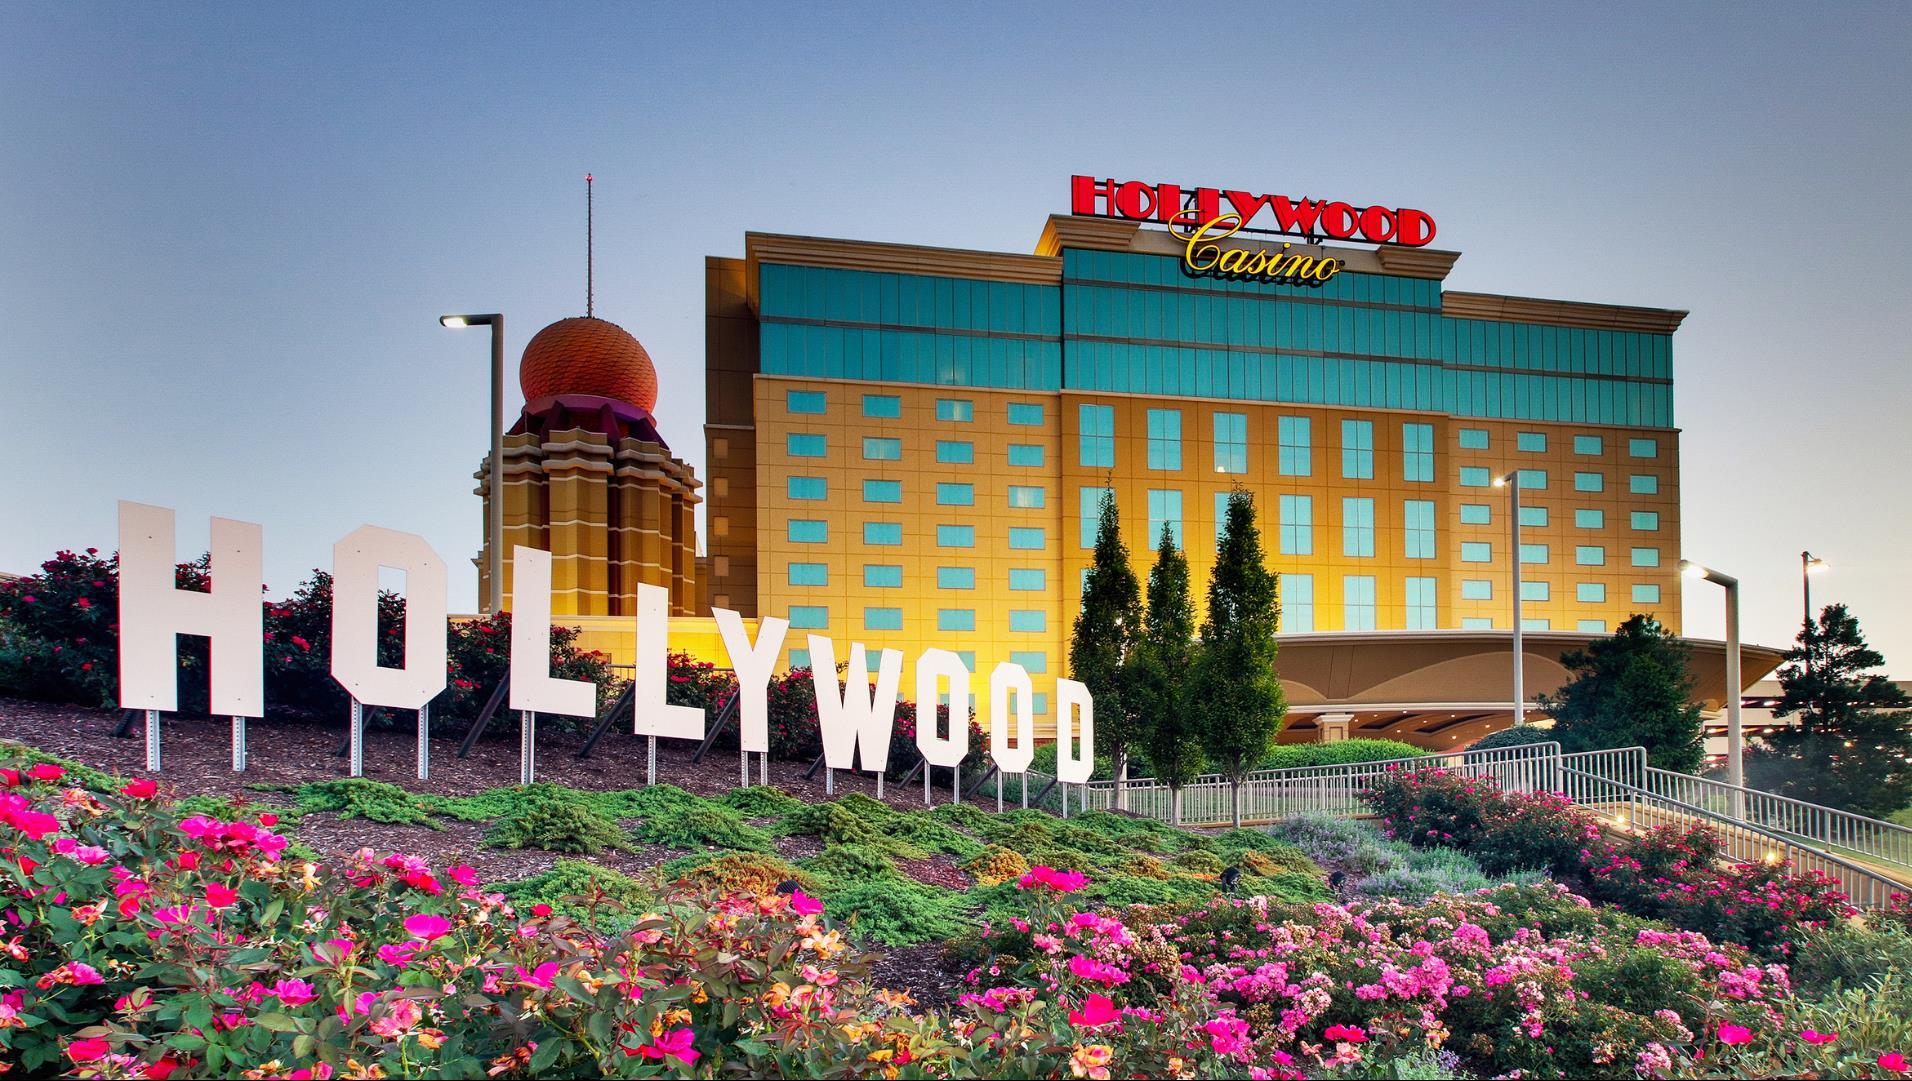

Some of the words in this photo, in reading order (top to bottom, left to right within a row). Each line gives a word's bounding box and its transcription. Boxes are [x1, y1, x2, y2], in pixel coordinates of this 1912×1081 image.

[1071, 174, 1437, 247] HOLLYWOOD
[1168, 209, 1340, 281] Casino
[118, 500, 1094, 784] HOLLYWOOD
